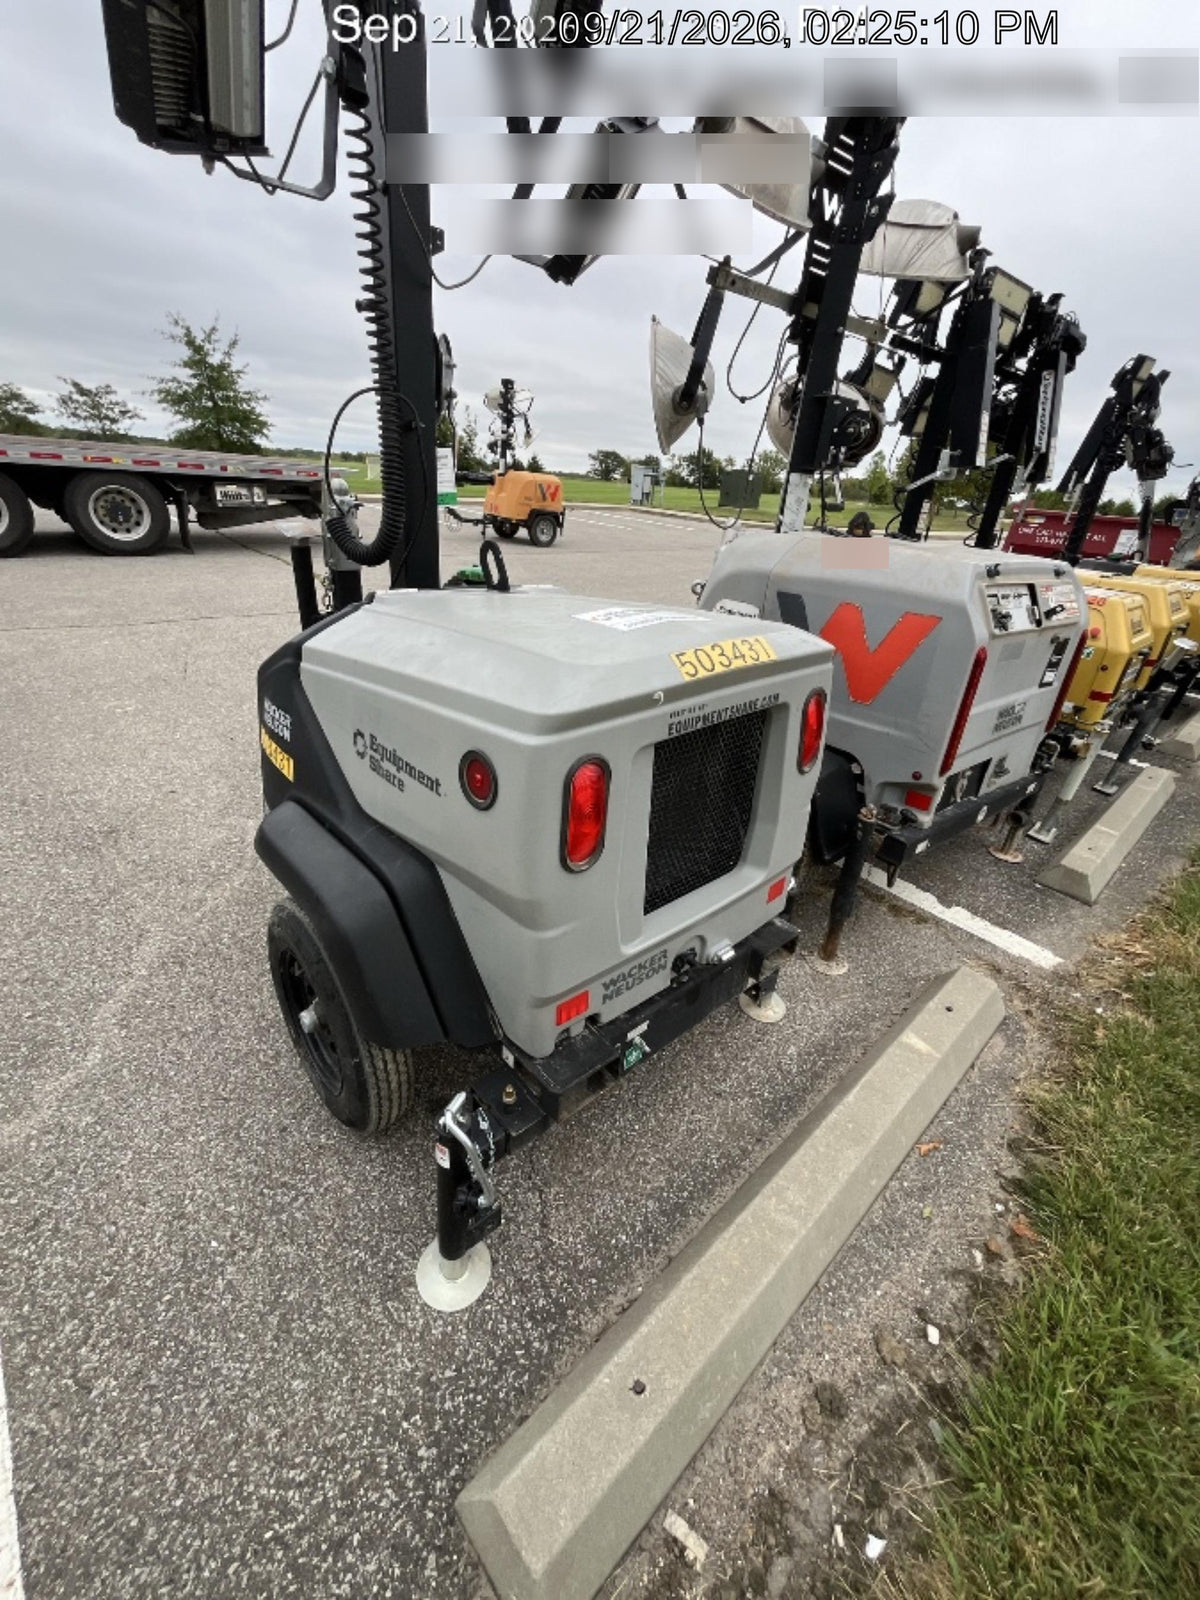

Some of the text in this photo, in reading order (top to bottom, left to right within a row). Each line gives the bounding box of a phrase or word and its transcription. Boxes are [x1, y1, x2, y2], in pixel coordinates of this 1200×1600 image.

[675, 637, 771, 678] 503431
[368, 732, 443, 798] Equipment
[368, 755, 406, 794] Share
[601, 948, 669, 993] WACKER
[601, 960, 668, 1006] NEUSON
